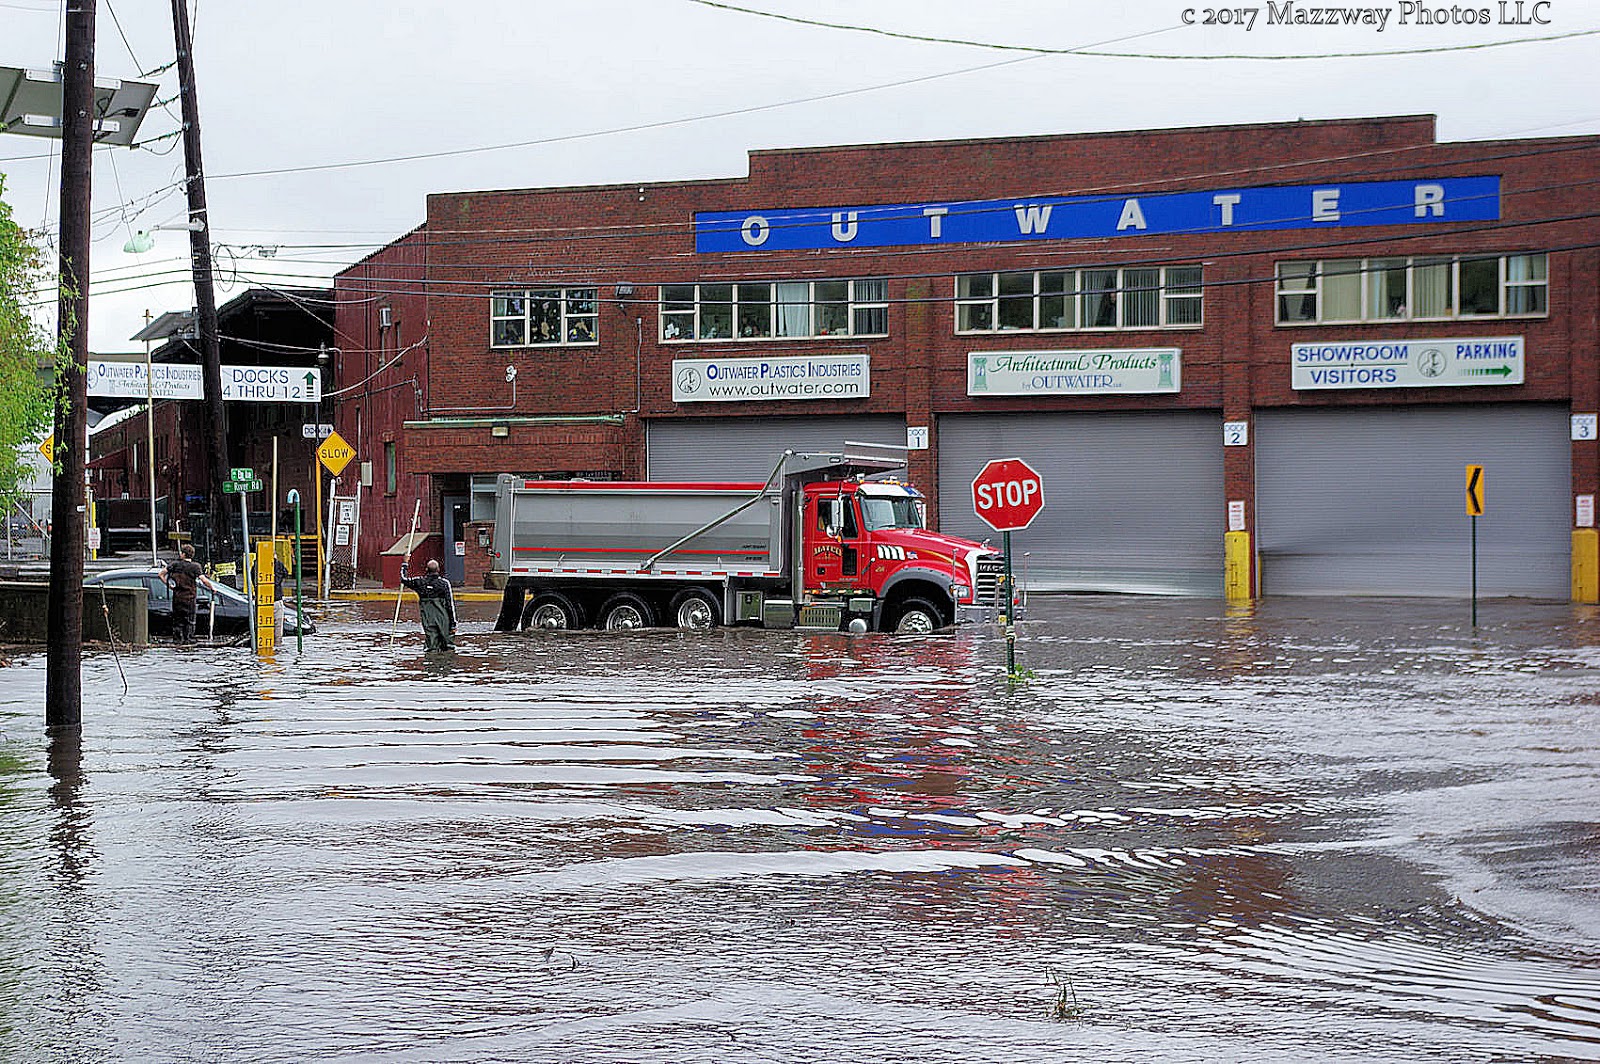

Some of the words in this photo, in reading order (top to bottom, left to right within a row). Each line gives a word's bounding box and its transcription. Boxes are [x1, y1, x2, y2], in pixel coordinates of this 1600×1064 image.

[1297, 345, 1408, 362] SHOWROOM
[1456, 343, 1517, 361] PARKING
[988, 354, 1090, 373] Architectural
[1092, 350, 1157, 371] Products
[135, 365, 165, 380] PLATICS
[232, 369, 289, 384] DOCKS
[706, 364, 758, 380] OUTWATER
[760, 363, 806, 379] PLASTICS
[808, 361, 861, 377] INDUSTRIES
[1310, 368, 1397, 385] VISITORS
[709, 382, 859, 396] www.outwater.com
[1031, 374, 1114, 390] OUTWATER
[222, 385, 231, 396] 4
[237, 385, 275, 398] THRU
[282, 386, 301, 399] 12
[1231, 432, 1240, 444] 2
[1579, 425, 1589, 438] 3
[916, 436, 920, 447] 1
[321, 448, 349, 459] SLOW
[977, 479, 1038, 510] STOP
[265, 572, 273, 582] FT
[265, 594, 272, 604] FT
[265, 616, 273, 625] FT
[265, 637, 272, 647] FT
